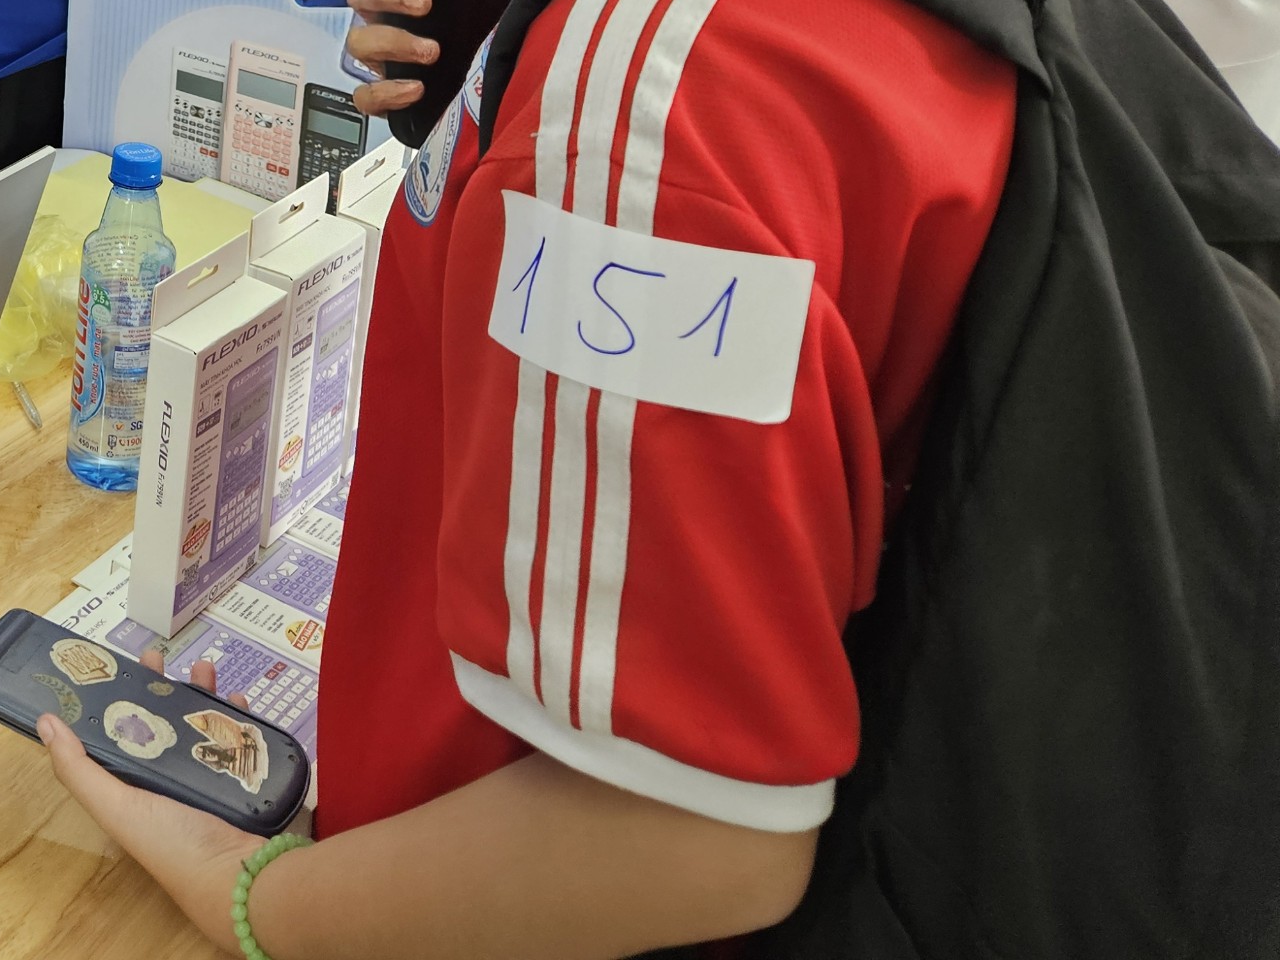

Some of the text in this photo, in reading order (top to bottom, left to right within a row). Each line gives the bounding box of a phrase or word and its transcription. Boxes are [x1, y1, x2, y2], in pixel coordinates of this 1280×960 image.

[241, 46, 281, 62] FLEXIO
[297, 255, 344, 296] FLEXIO
[202, 324, 259, 371] FLEXIO
[126, 437, 142, 447] 190
[158, 400, 173, 471] FLEXIO
[294, 620, 317, 649] BẢO HÀNH
